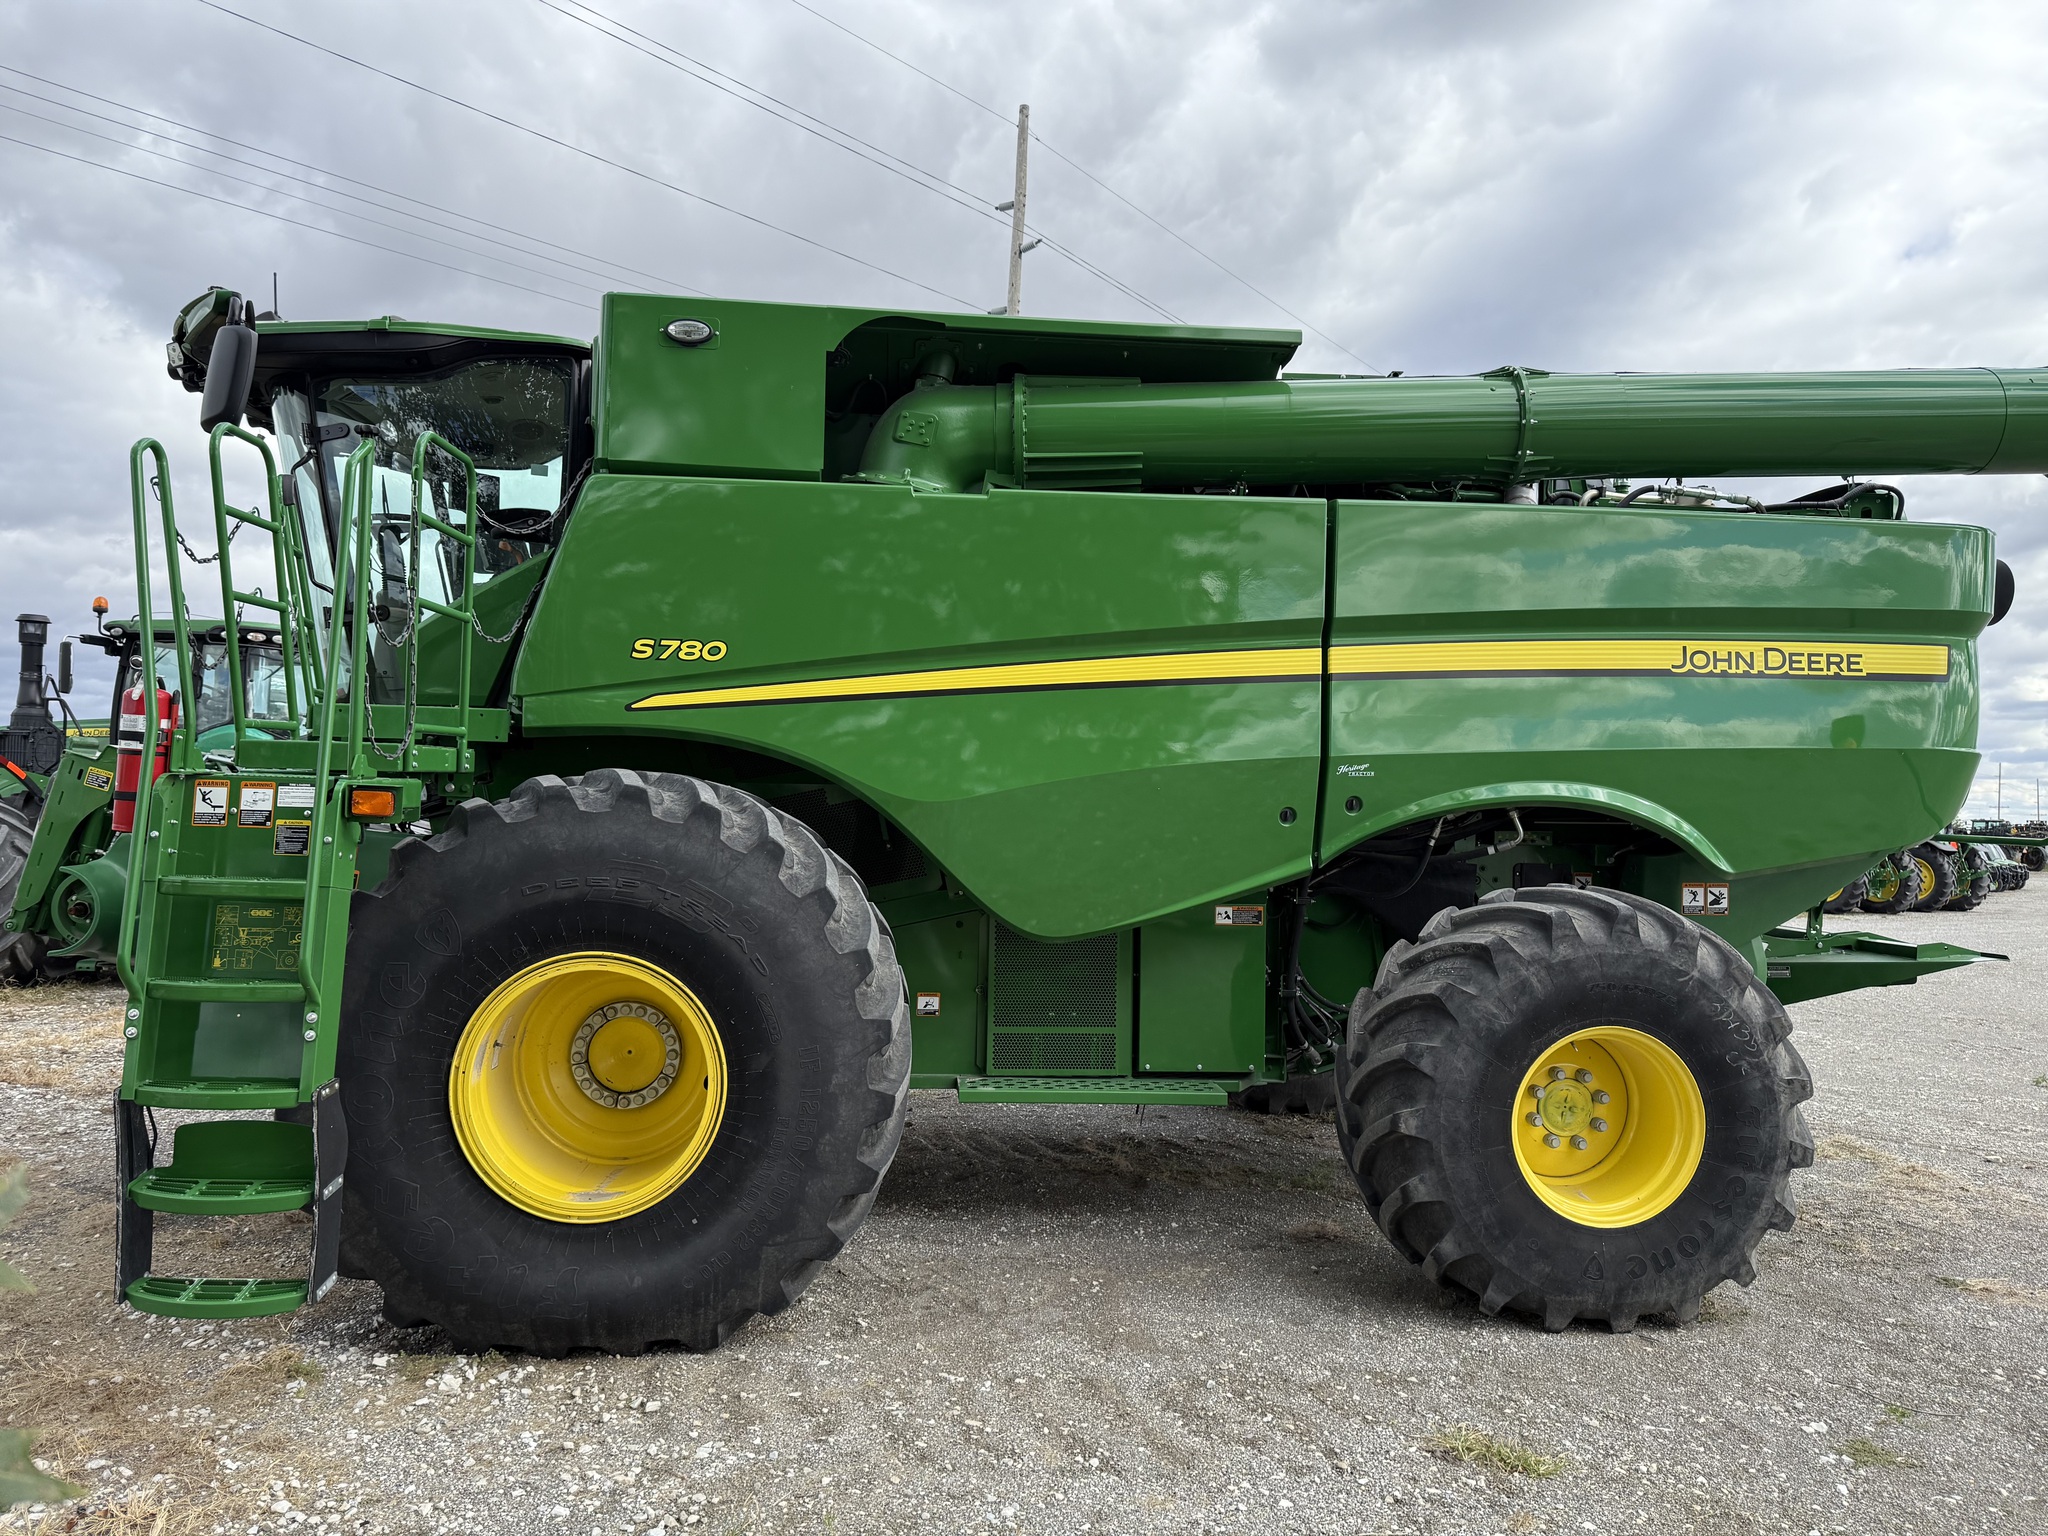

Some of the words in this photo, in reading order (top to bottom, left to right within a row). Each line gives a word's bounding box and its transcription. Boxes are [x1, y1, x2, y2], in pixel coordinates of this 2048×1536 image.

[631, 637, 728, 662] S780
[1671, 645, 1755, 672] JOHN
[1764, 646, 1864, 674] DEERE
[1336, 763, 1370, 776] Heritage
[520, 877, 641, 897] DEEP
[656, 884, 772, 978] TREAD
[344, 960, 589, 1320] Firestone
[1625, 1105, 1761, 1281] Firestone
